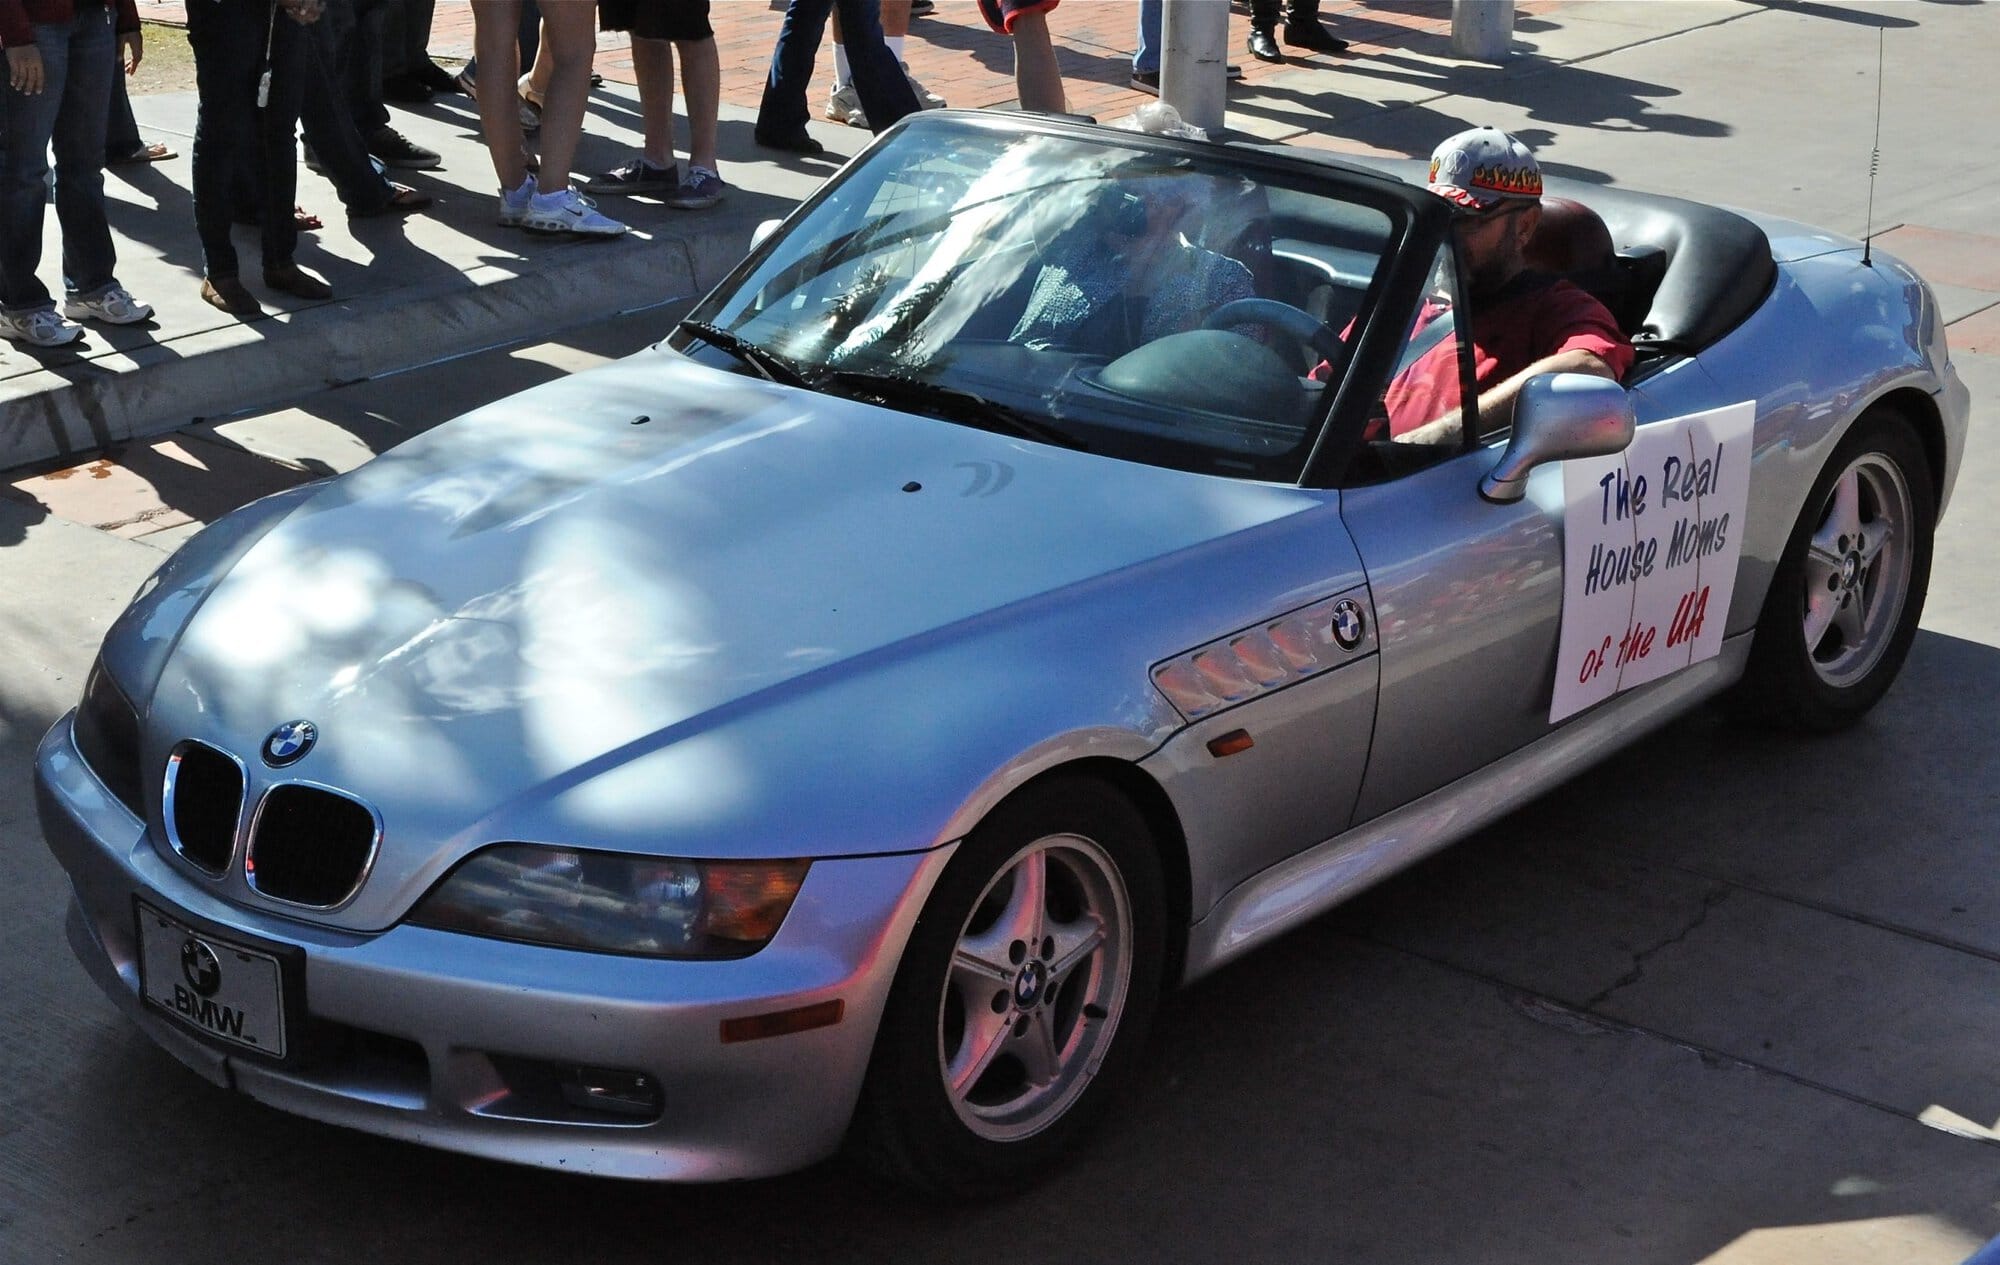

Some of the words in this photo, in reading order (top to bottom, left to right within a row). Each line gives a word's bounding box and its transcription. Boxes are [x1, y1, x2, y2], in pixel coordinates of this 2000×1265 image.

[1600, 469, 1648, 525] The
[1662, 443, 1723, 508] Real
[1585, 538, 1658, 596] House
[1665, 513, 1730, 569] Moms
[1579, 635, 1612, 683] of
[1616, 622, 1656, 667] the
[1666, 586, 1710, 648] UA
[174, 984, 245, 1036] BMW
